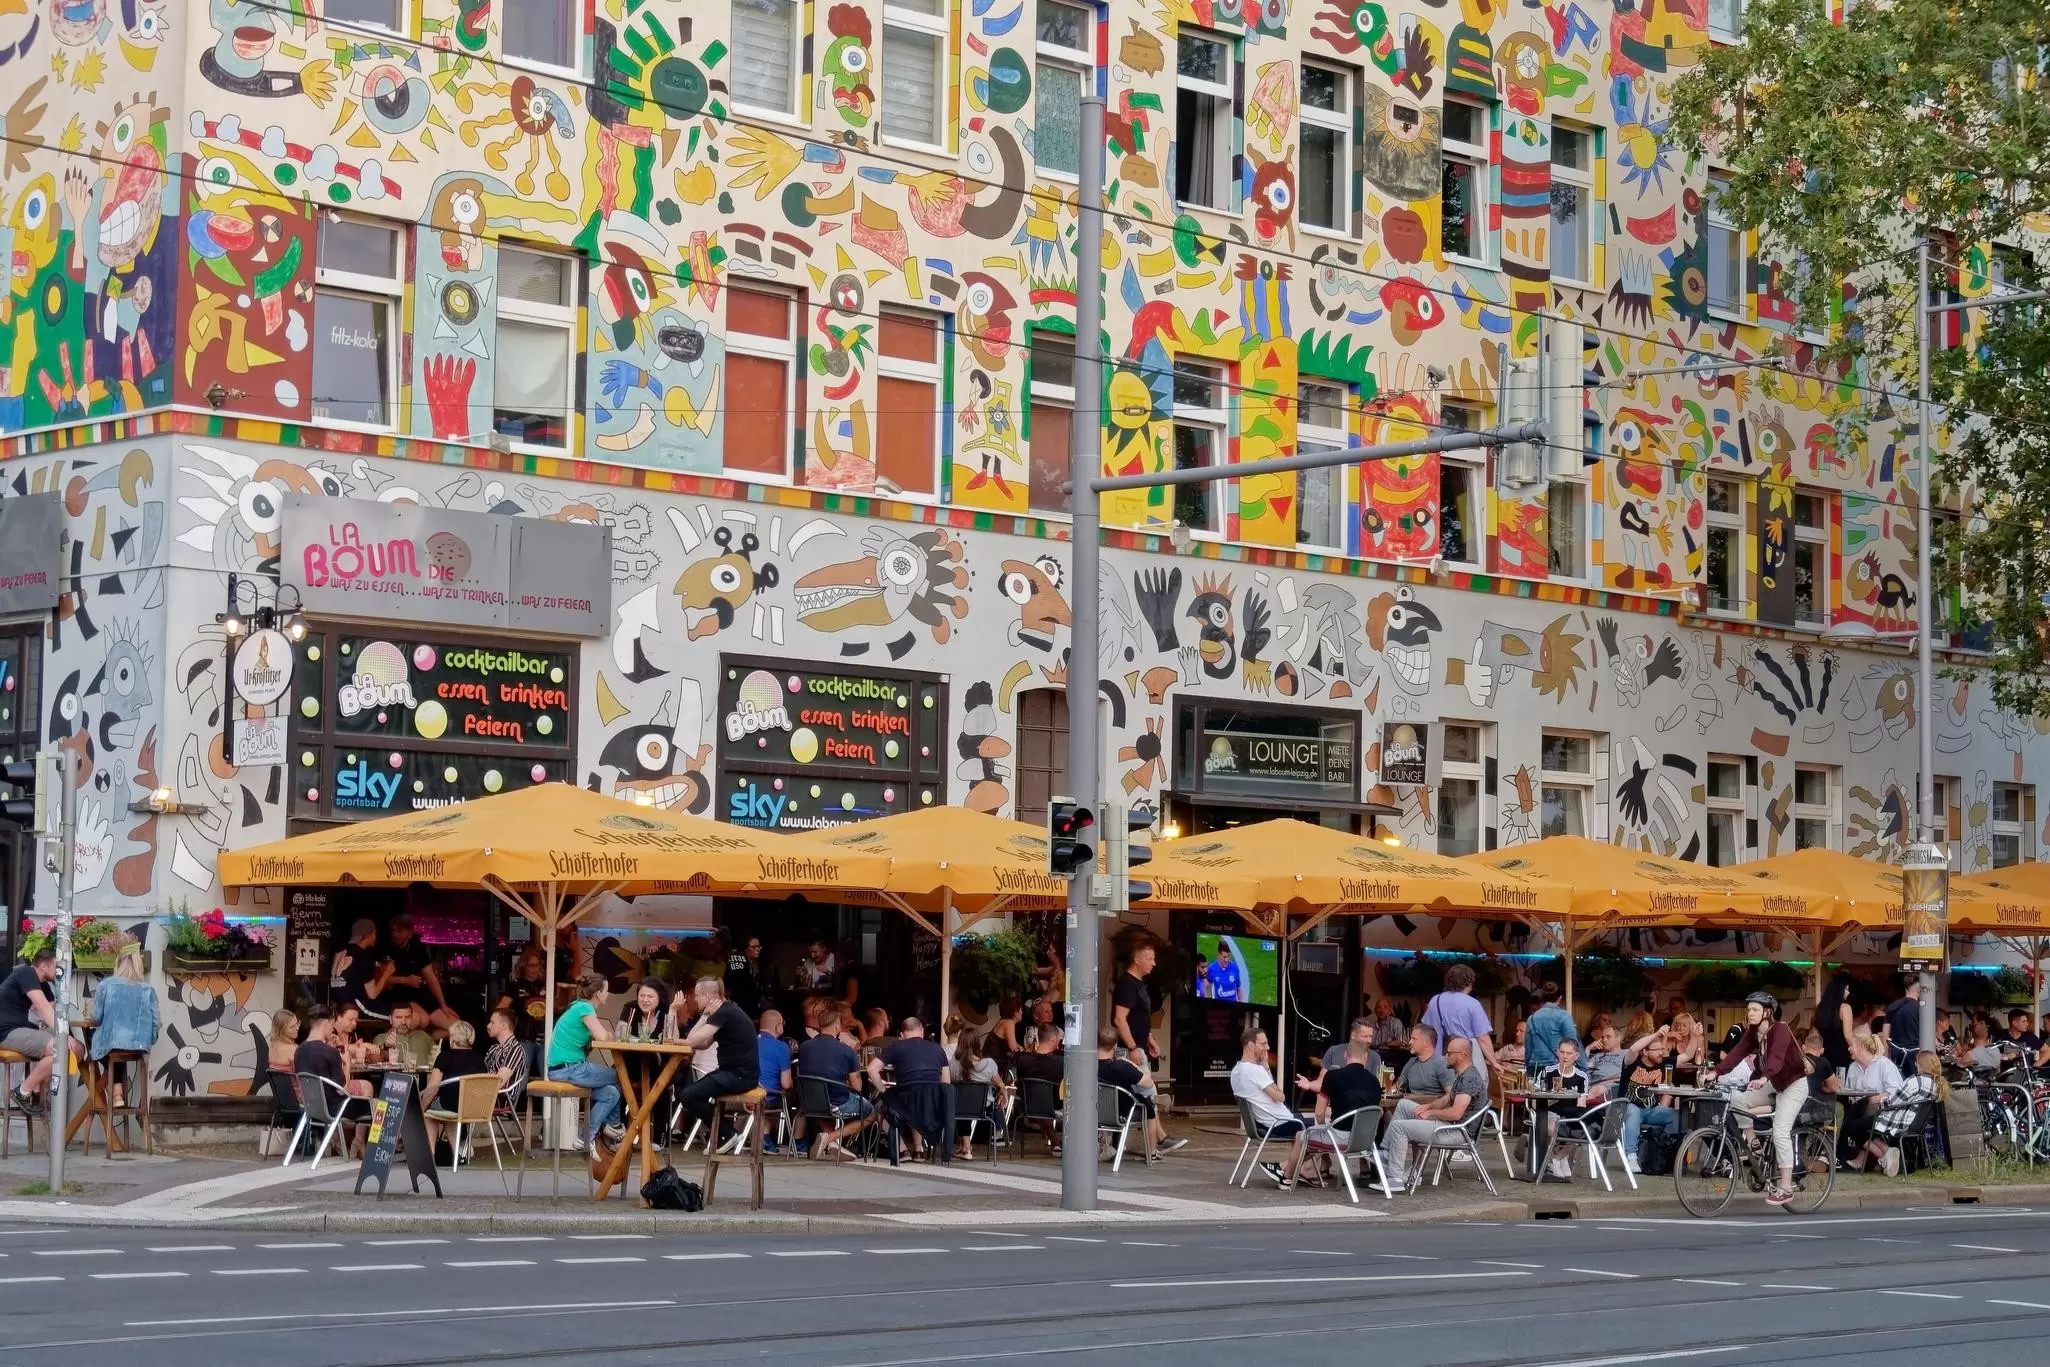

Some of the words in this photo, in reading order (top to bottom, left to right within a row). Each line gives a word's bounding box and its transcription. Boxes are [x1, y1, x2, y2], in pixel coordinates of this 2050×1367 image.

[330, 325, 378, 349] fritz-kola
[329, 522, 364, 550] LA
[330, 577, 352, 591] WAS
[354, 579, 370, 592] ZU
[557, 596, 592, 613] FEIERN
[445, 649, 549, 676] cocktailbar
[437, 682, 490, 706] essen
[500, 682, 569, 712] trinken
[807, 677, 897, 701] cocktailbar
[800, 709, 845, 732] essen
[852, 710, 910, 736] trinken
[1249, 740, 1319, 765] LOUNGE
[1328, 744, 1350, 757] MIETE
[1249, 766, 1318, 780] www.laboum-leipzig.de
[1328, 758, 1350, 770] DEINE
[1386, 769, 1423, 783] LOUNGE
[336, 760, 402, 808] sky
[336, 797, 381, 808] sportsbar
[730, 783, 787, 828] sky
[730, 818, 768, 828] sportsbar
[247, 853, 304, 882] Schöfferhofer
[383, 851, 446, 880] Schöfferhofer
[549, 848, 639, 878] Schöfferhofer
[756, 853, 840, 883] Schöfferhofer
[1154, 875, 1220, 903] Schöfferhofer
[1338, 877, 1401, 902] Schöfferhofer
[1480, 880, 1538, 907] Schöfferhofer
[1648, 890, 1699, 913] Schöfferhofer
[1761, 895, 1808, 915] Schöfferhofer
[1996, 902, 2042, 924] Schöfferhofer
